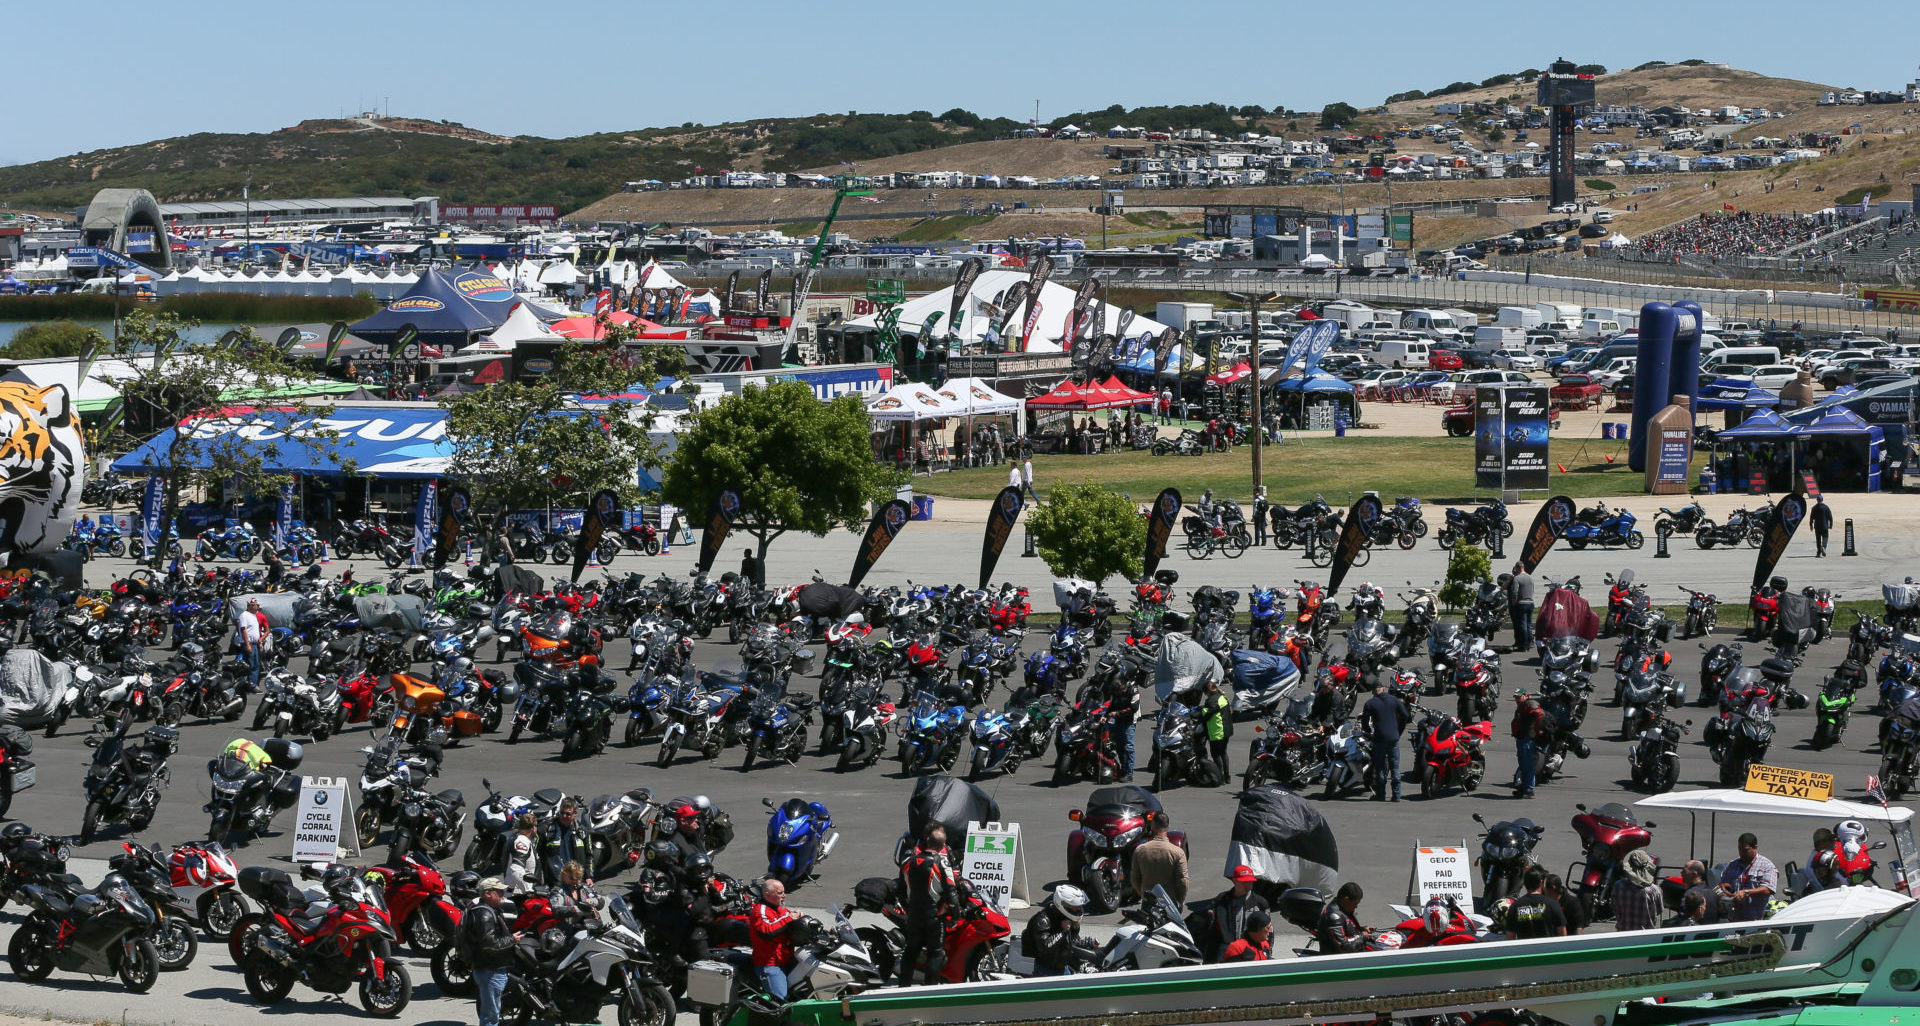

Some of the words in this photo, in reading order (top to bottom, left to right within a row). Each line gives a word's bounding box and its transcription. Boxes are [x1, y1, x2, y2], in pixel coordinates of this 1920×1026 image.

[445, 207, 468, 217] MOTUL
[473, 207, 497, 217] MOTUL
[501, 207, 525, 217] MOTUL
[530, 207, 555, 217] MOTUL
[291, 243, 347, 264] SUZUKI
[458, 280, 484, 292] CYCLE
[482, 278, 505, 288] GEAR
[392, 300, 414, 308] CYCLE
[1024, 305, 1040, 337] MOTUL
[808, 379, 890, 400] UZUKI
[424, 484, 436, 538] SUZUKI
[868, 524, 886, 547] LAW
[1529, 523, 1548, 548] LAW
[866, 534, 892, 564] TIGERS
[1528, 535, 1555, 565] TIGERS
[1752, 765, 1806, 777] MONTEREY
[1751, 771, 1829, 789] VETERANS
[1766, 782, 1809, 797] TAXI
[296, 834, 336, 842] PARKING
[974, 862, 1003, 870] CYCLE
[969, 872, 1005, 881] CORRAL
[1424, 881, 1467, 889] PREFERRED
